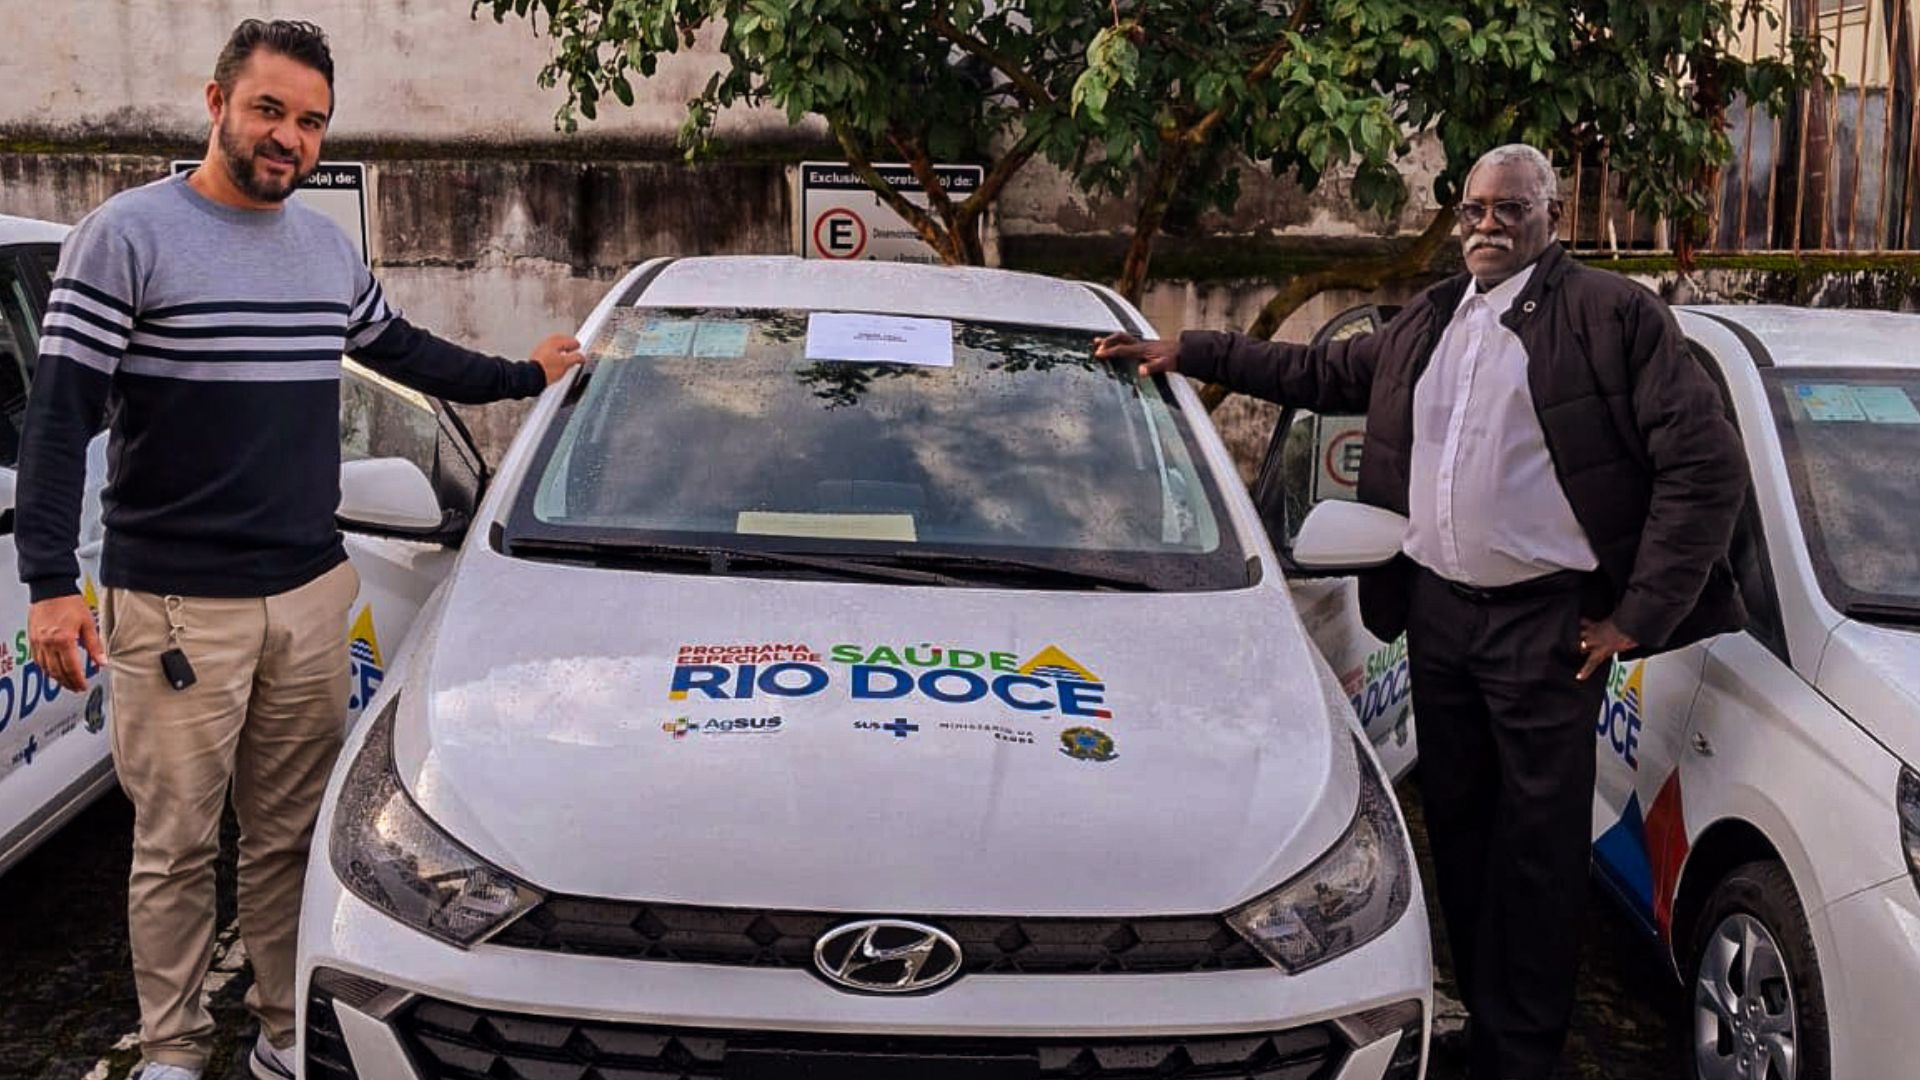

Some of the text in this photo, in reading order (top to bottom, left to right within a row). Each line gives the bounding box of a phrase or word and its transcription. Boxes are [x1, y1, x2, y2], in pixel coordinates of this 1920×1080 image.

[830, 219, 853, 249] E
[1344, 443, 1363, 472] E
[677, 653, 821, 664] ESPECIAL DE
[679, 644, 809, 655] PROGRAMA
[832, 643, 1018, 673] SAÚDE
[669, 662, 1112, 719] RIO DOCE
[704, 716, 782, 730] AgSUS
[853, 721, 880, 729] SUS
[1596, 690, 1641, 772] OCE
